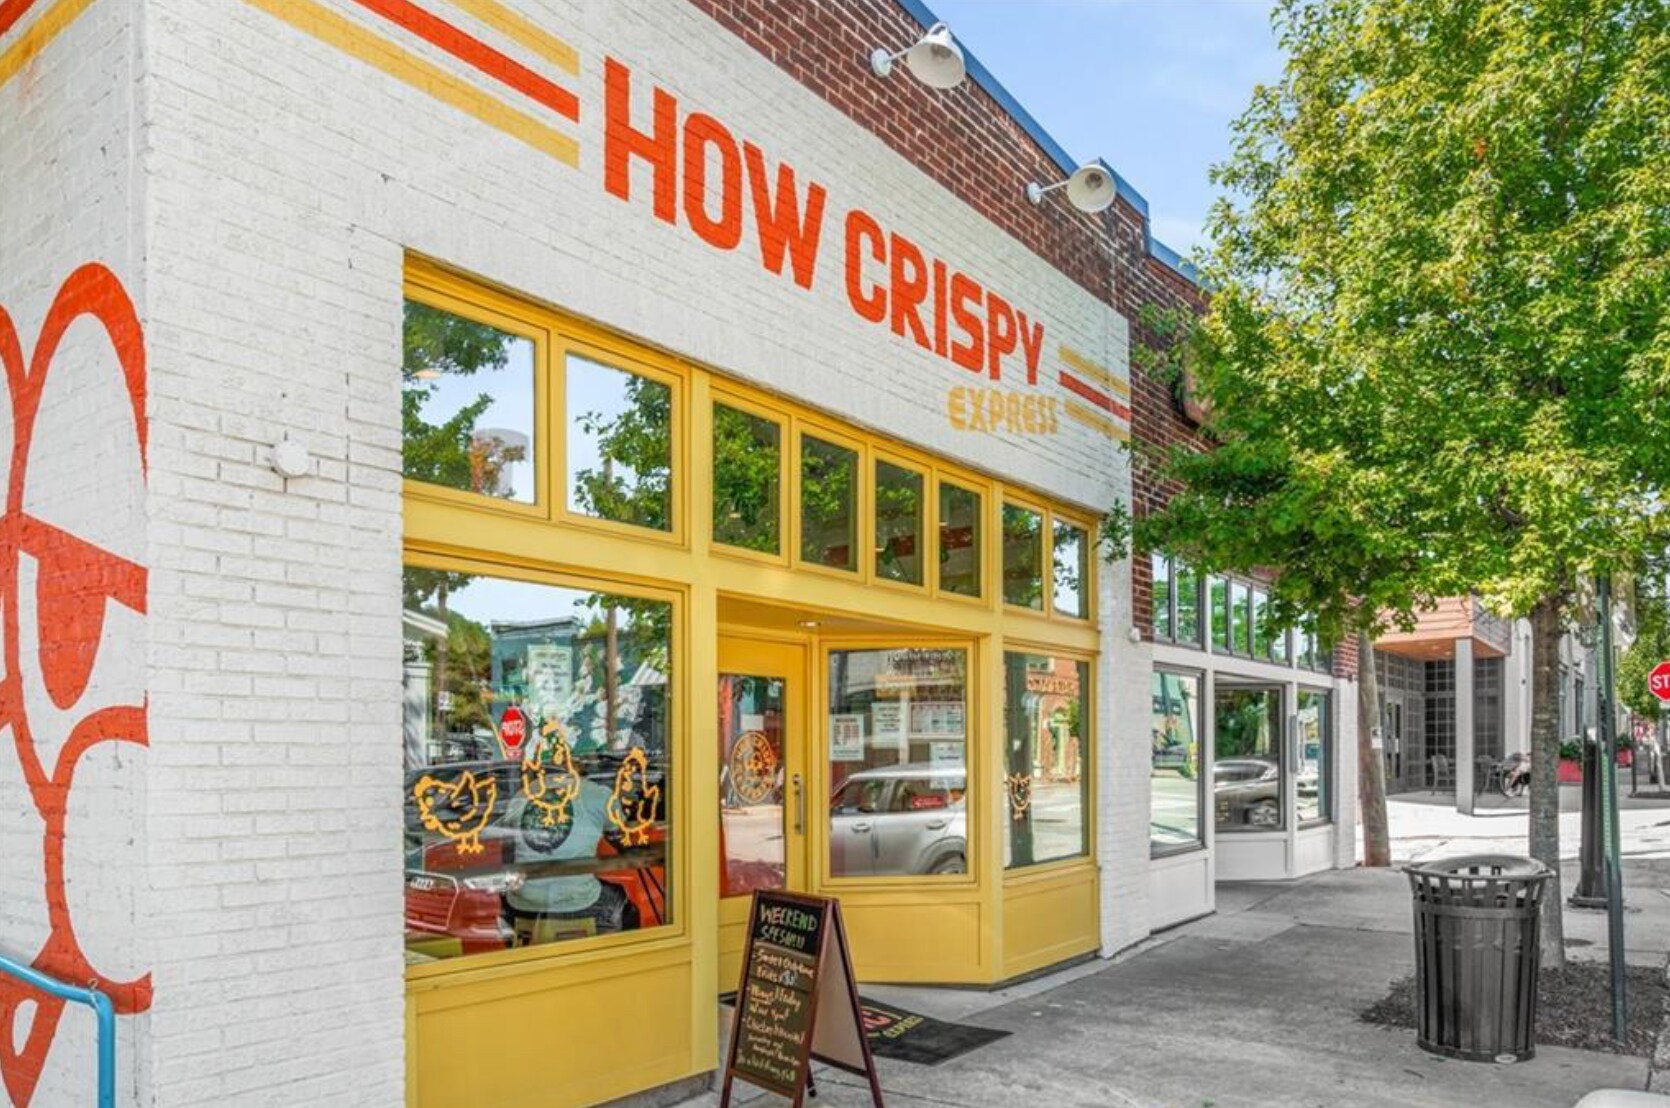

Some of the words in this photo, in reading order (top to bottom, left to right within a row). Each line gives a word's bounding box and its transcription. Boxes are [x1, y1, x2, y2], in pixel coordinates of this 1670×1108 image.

[604, 56, 826, 290] HOW
[845, 209, 1044, 386] CRISPY
[948, 386, 1058, 434] EXPRESS
